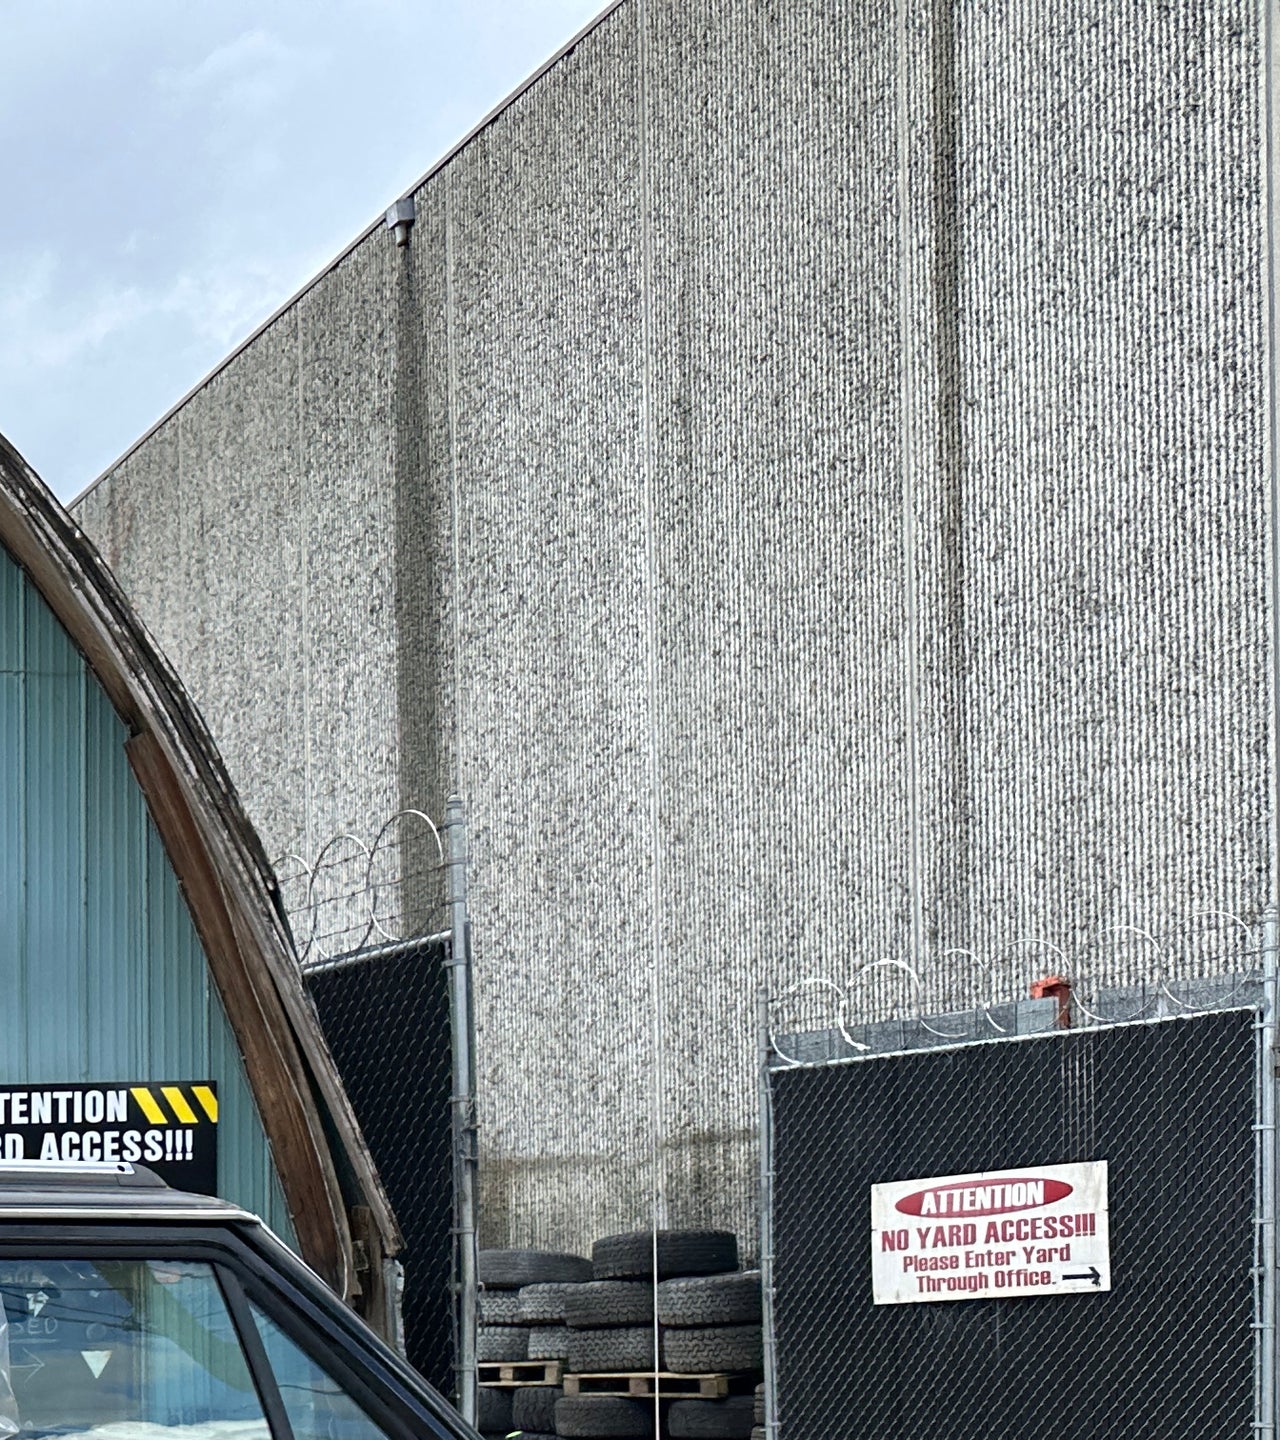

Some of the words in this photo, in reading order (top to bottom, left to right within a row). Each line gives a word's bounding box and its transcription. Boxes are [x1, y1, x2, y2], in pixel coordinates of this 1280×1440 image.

[40, 1128, 194, 1163] ACCESS!!!
[920, 1180, 1045, 1216] ATTENTION
[881, 1228, 910, 1253] NO
[916, 1223, 977, 1248] YARD
[984, 1212, 1096, 1244] ACCESS!!!
[903, 1253, 960, 1273] Please
[965, 1249, 1017, 1269] Enter
[1022, 1243, 1071, 1265] Yard
[916, 1272, 990, 1294] Through
[995, 1267, 1057, 1288] Office.
